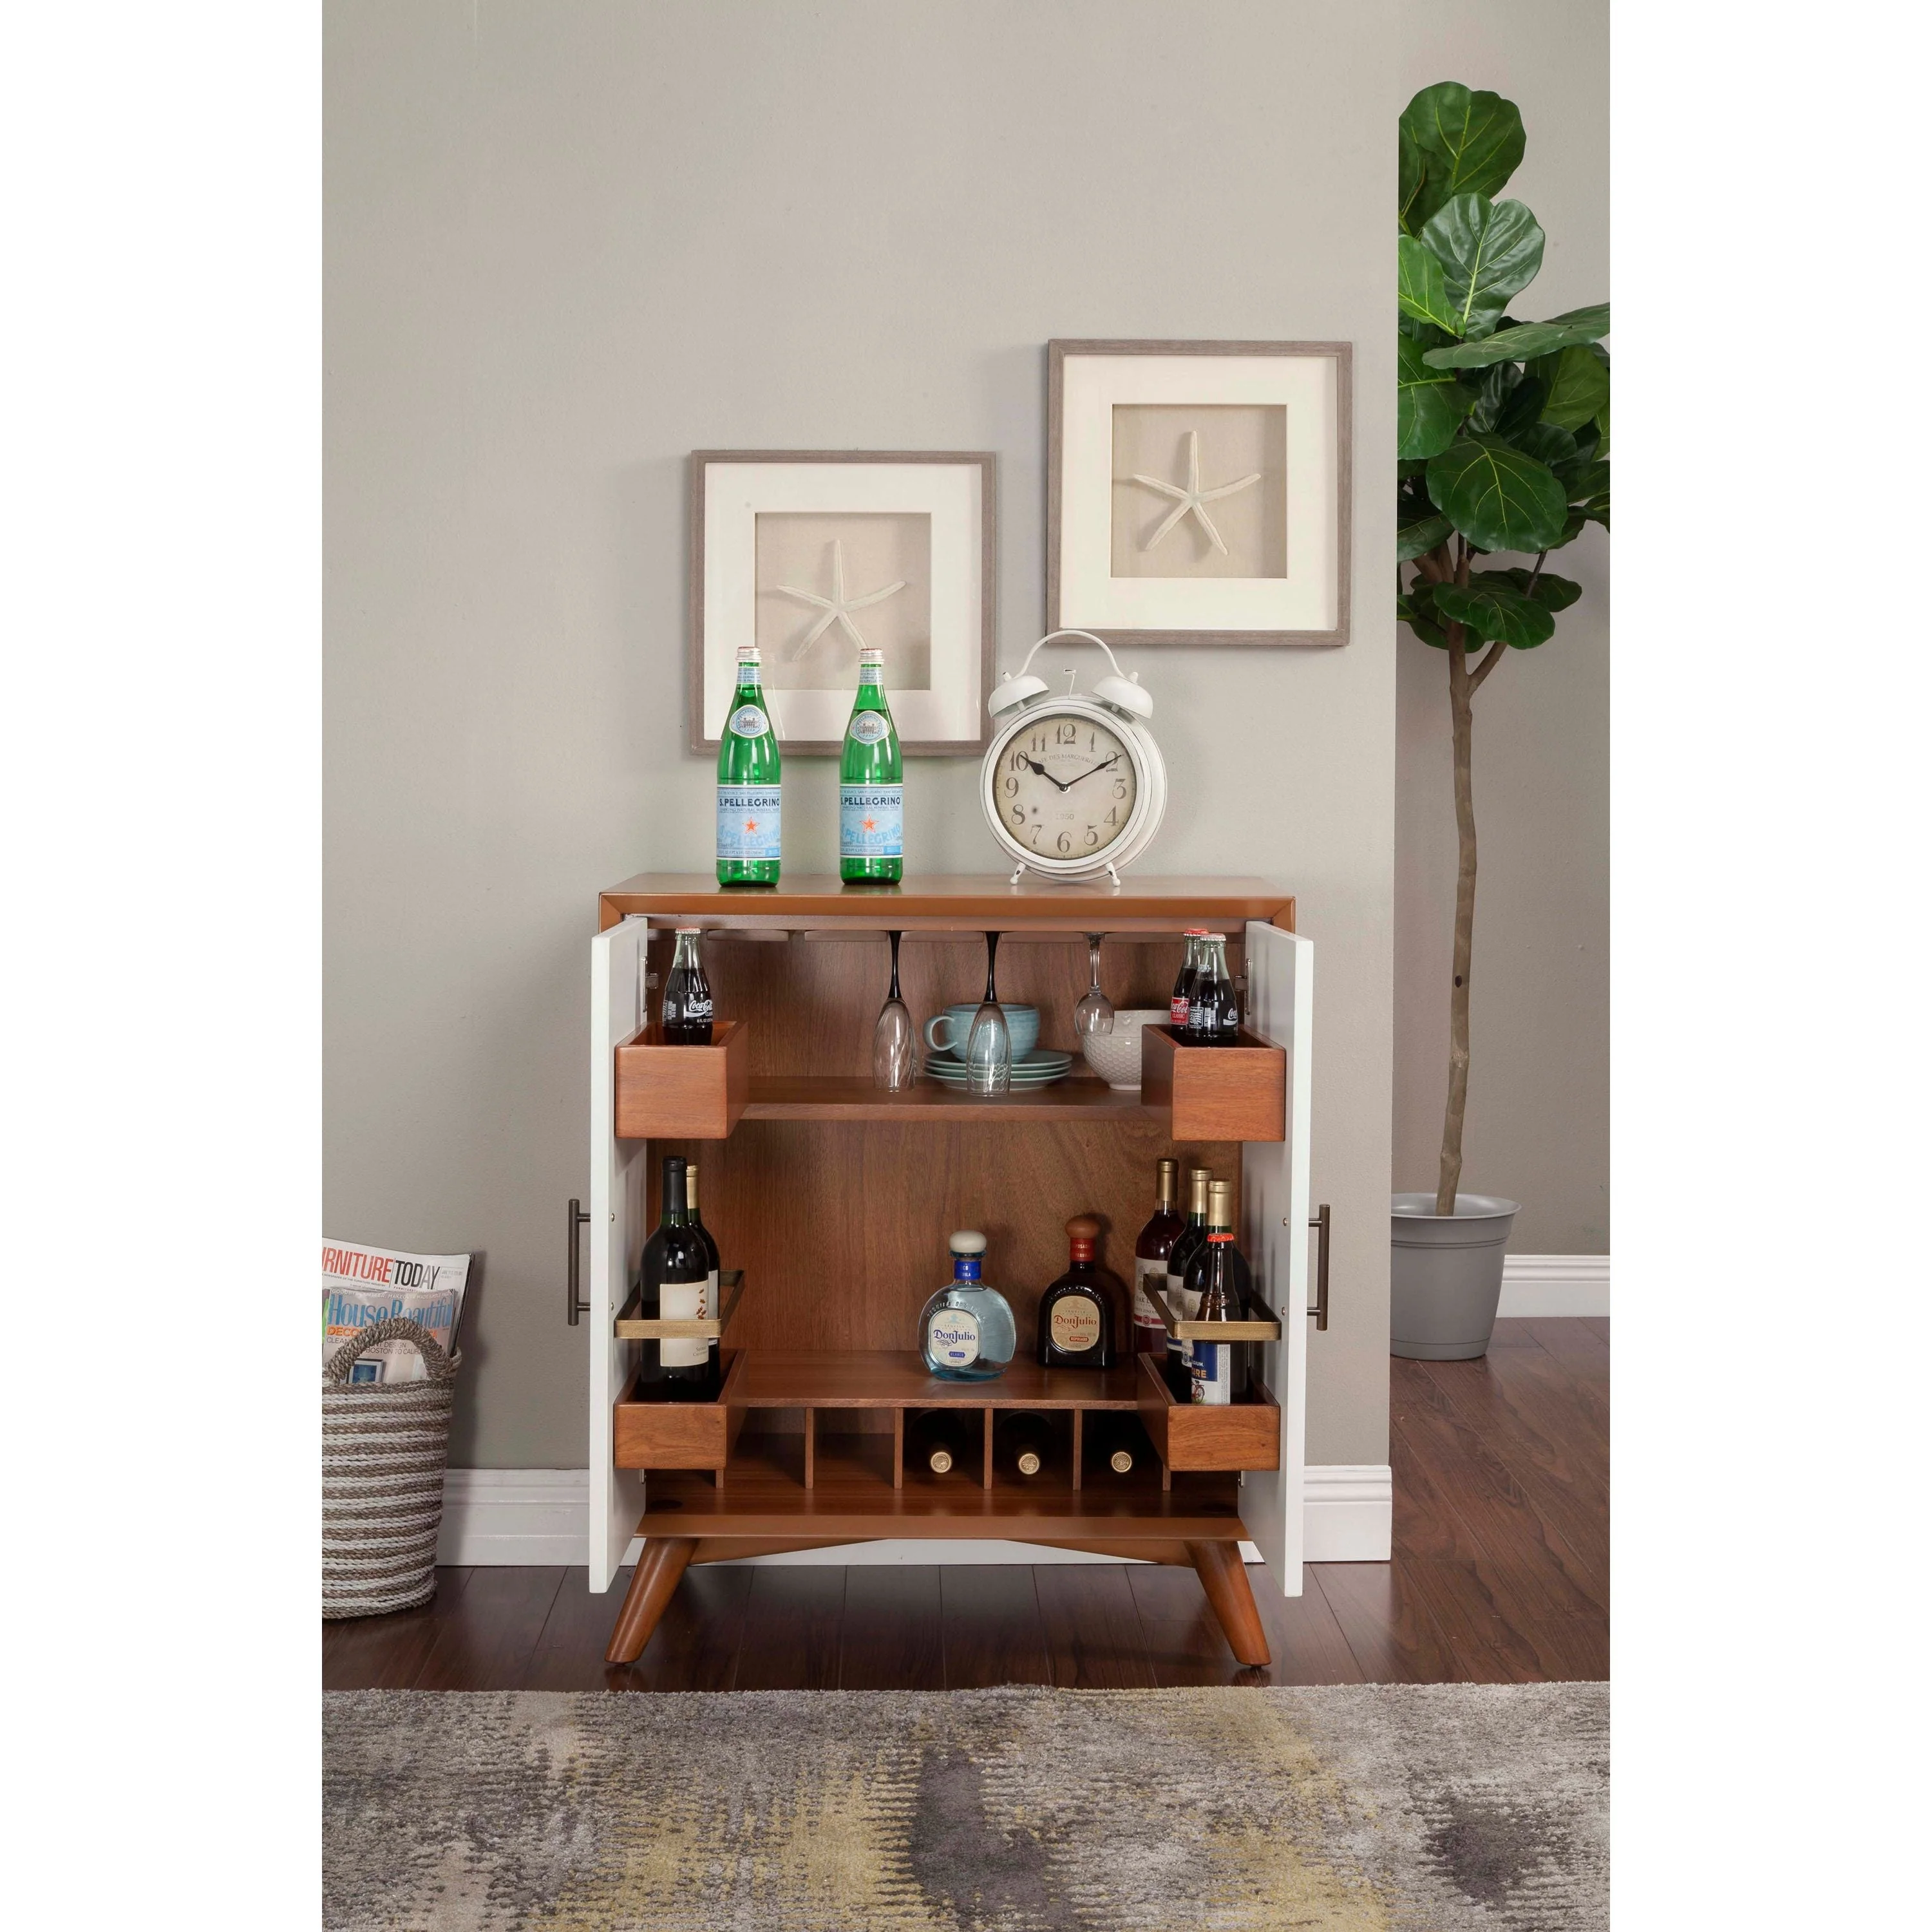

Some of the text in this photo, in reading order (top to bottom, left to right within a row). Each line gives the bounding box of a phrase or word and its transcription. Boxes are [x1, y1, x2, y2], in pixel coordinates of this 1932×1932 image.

[1031, 732, 1046, 752] 11
[1056, 723, 1076, 744] 12
[1089, 731, 1096, 752] 1
[1010, 750, 1029, 772] 10
[1105, 751, 1119, 772] 2
[1005, 777, 1019, 798] 9
[1112, 778, 1126, 799] 3
[719, 798, 780, 806] S.PELLEGRINO
[1011, 804, 1025, 825] 8
[1103, 806, 1119, 826] 4
[1030, 824, 1044, 844] 7
[1057, 831, 1072, 853] 6
[1084, 825, 1098, 846] 5
[395, 1260, 440, 1290] TODAY
[328, 1293, 388, 1327] House
